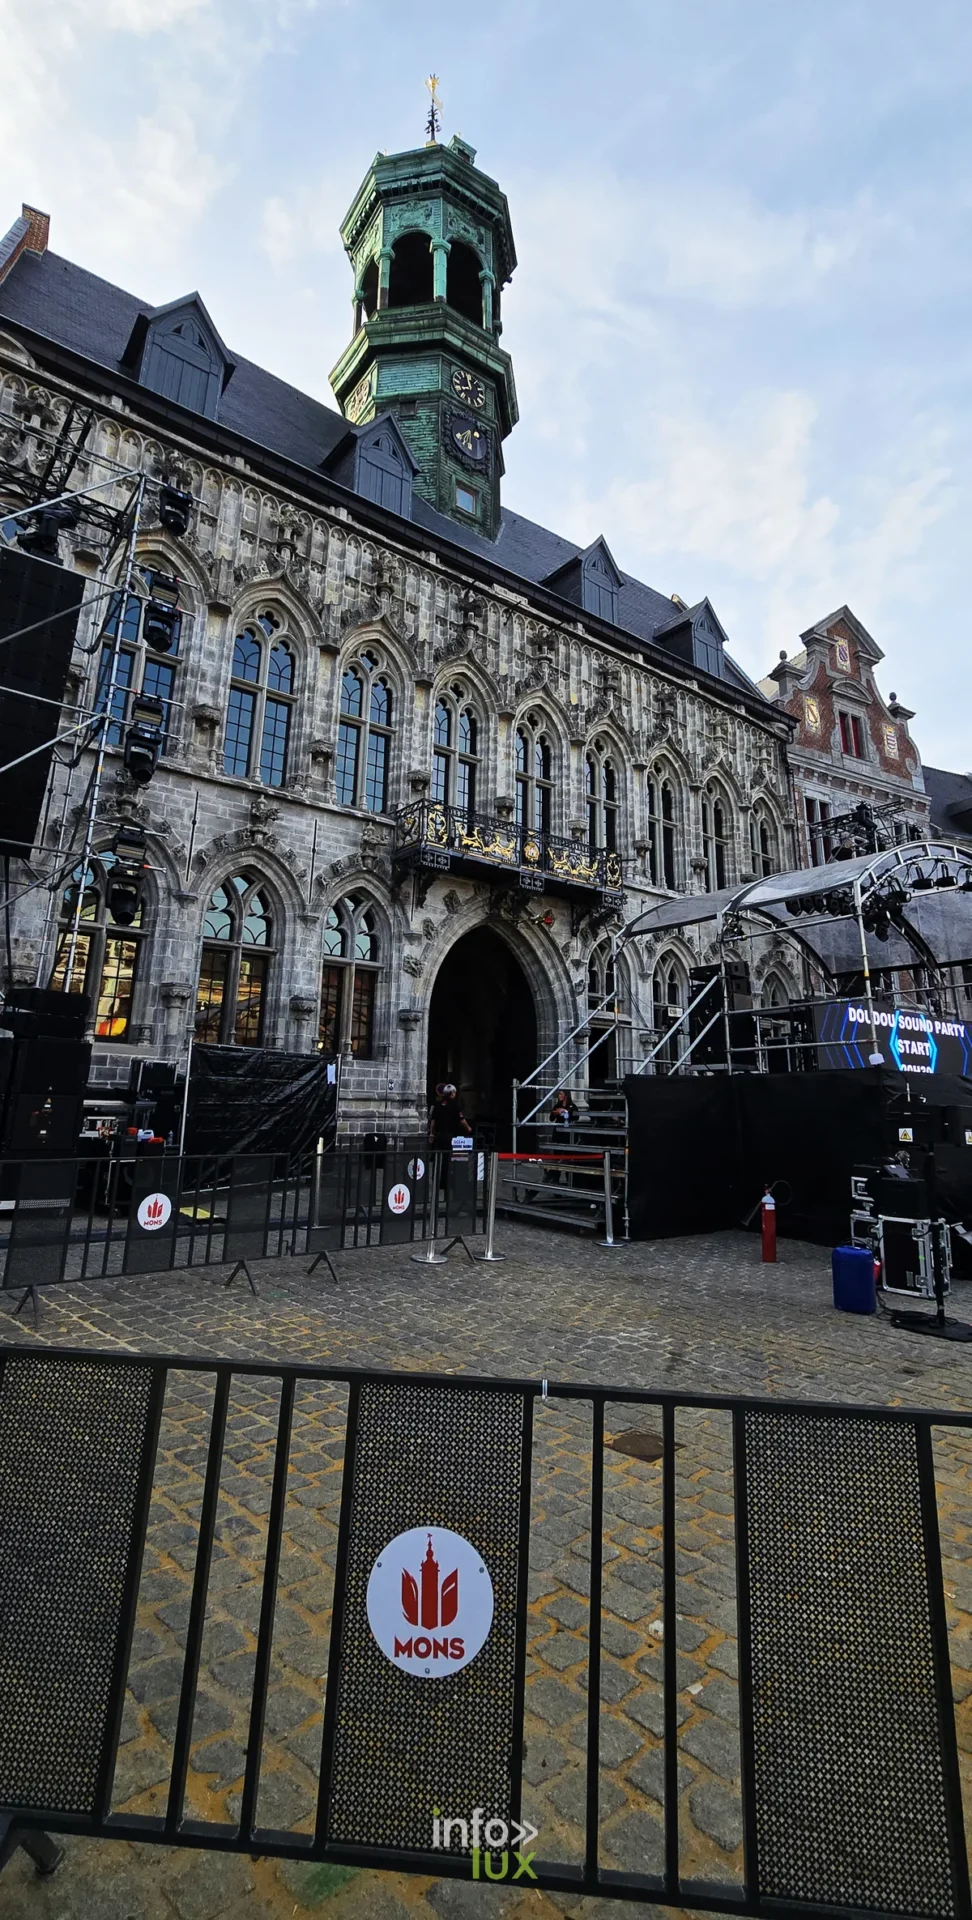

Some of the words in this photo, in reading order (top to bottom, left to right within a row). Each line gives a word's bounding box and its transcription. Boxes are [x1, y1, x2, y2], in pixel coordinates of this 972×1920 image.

[898, 1016, 933, 1032] SOUND
[934, 1021, 965, 1038] PARTY
[897, 1039, 930, 1056] START
[394, 1636, 465, 1660] MONS
